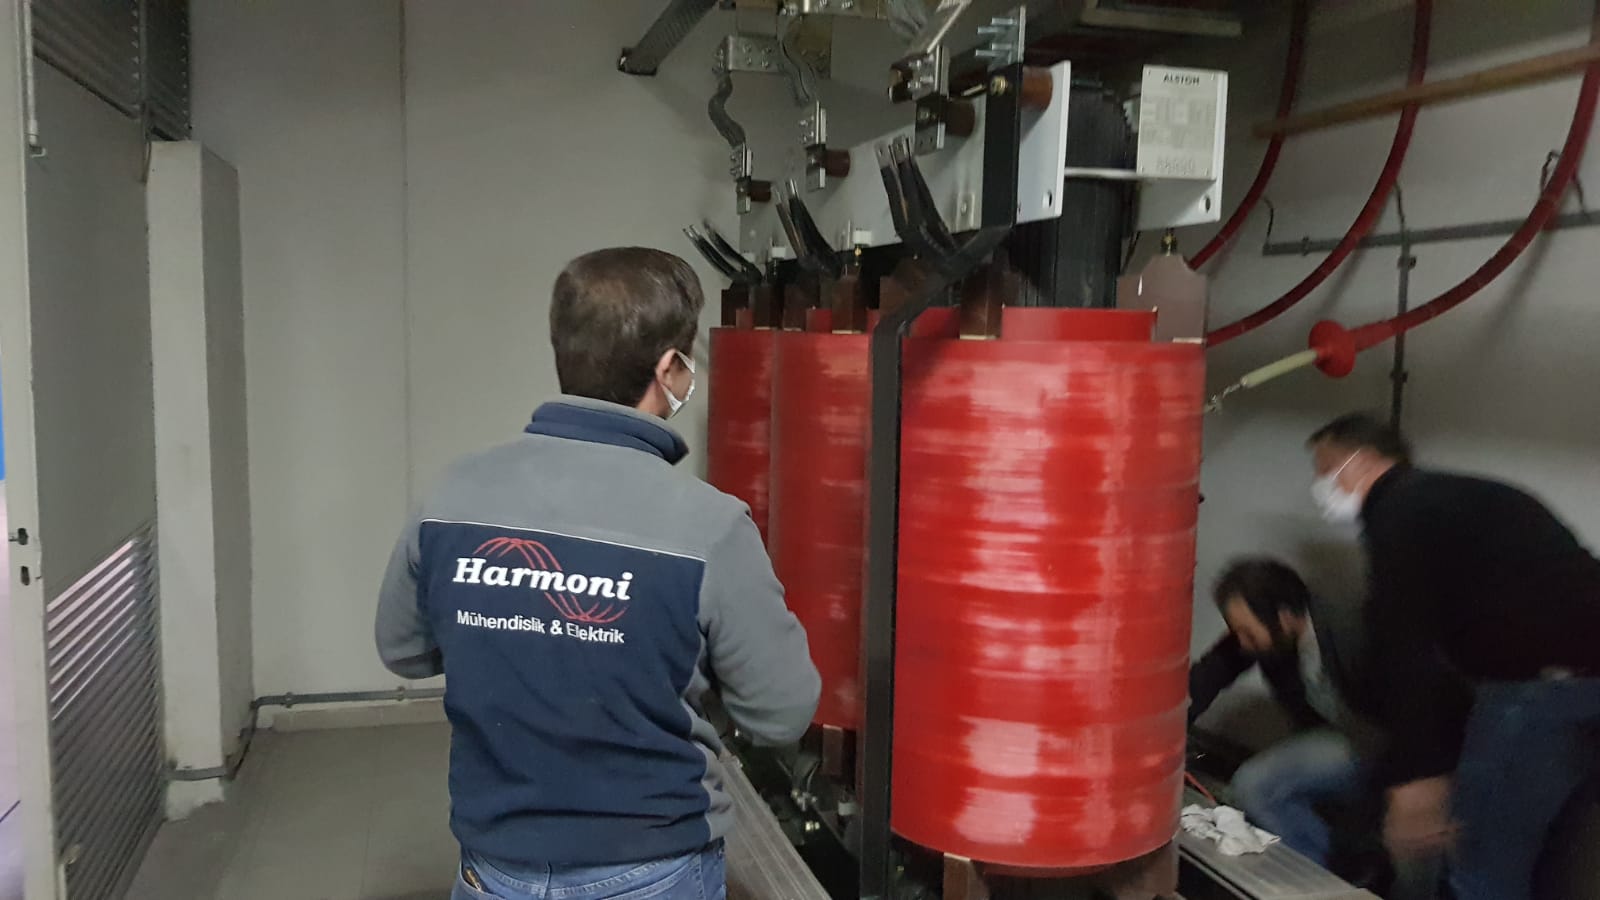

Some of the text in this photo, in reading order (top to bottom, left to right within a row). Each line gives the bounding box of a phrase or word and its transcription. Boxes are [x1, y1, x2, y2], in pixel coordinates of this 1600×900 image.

[452, 557, 634, 600] Harmoni
[457, 610, 625, 643] Mühendislik & Elektrik
